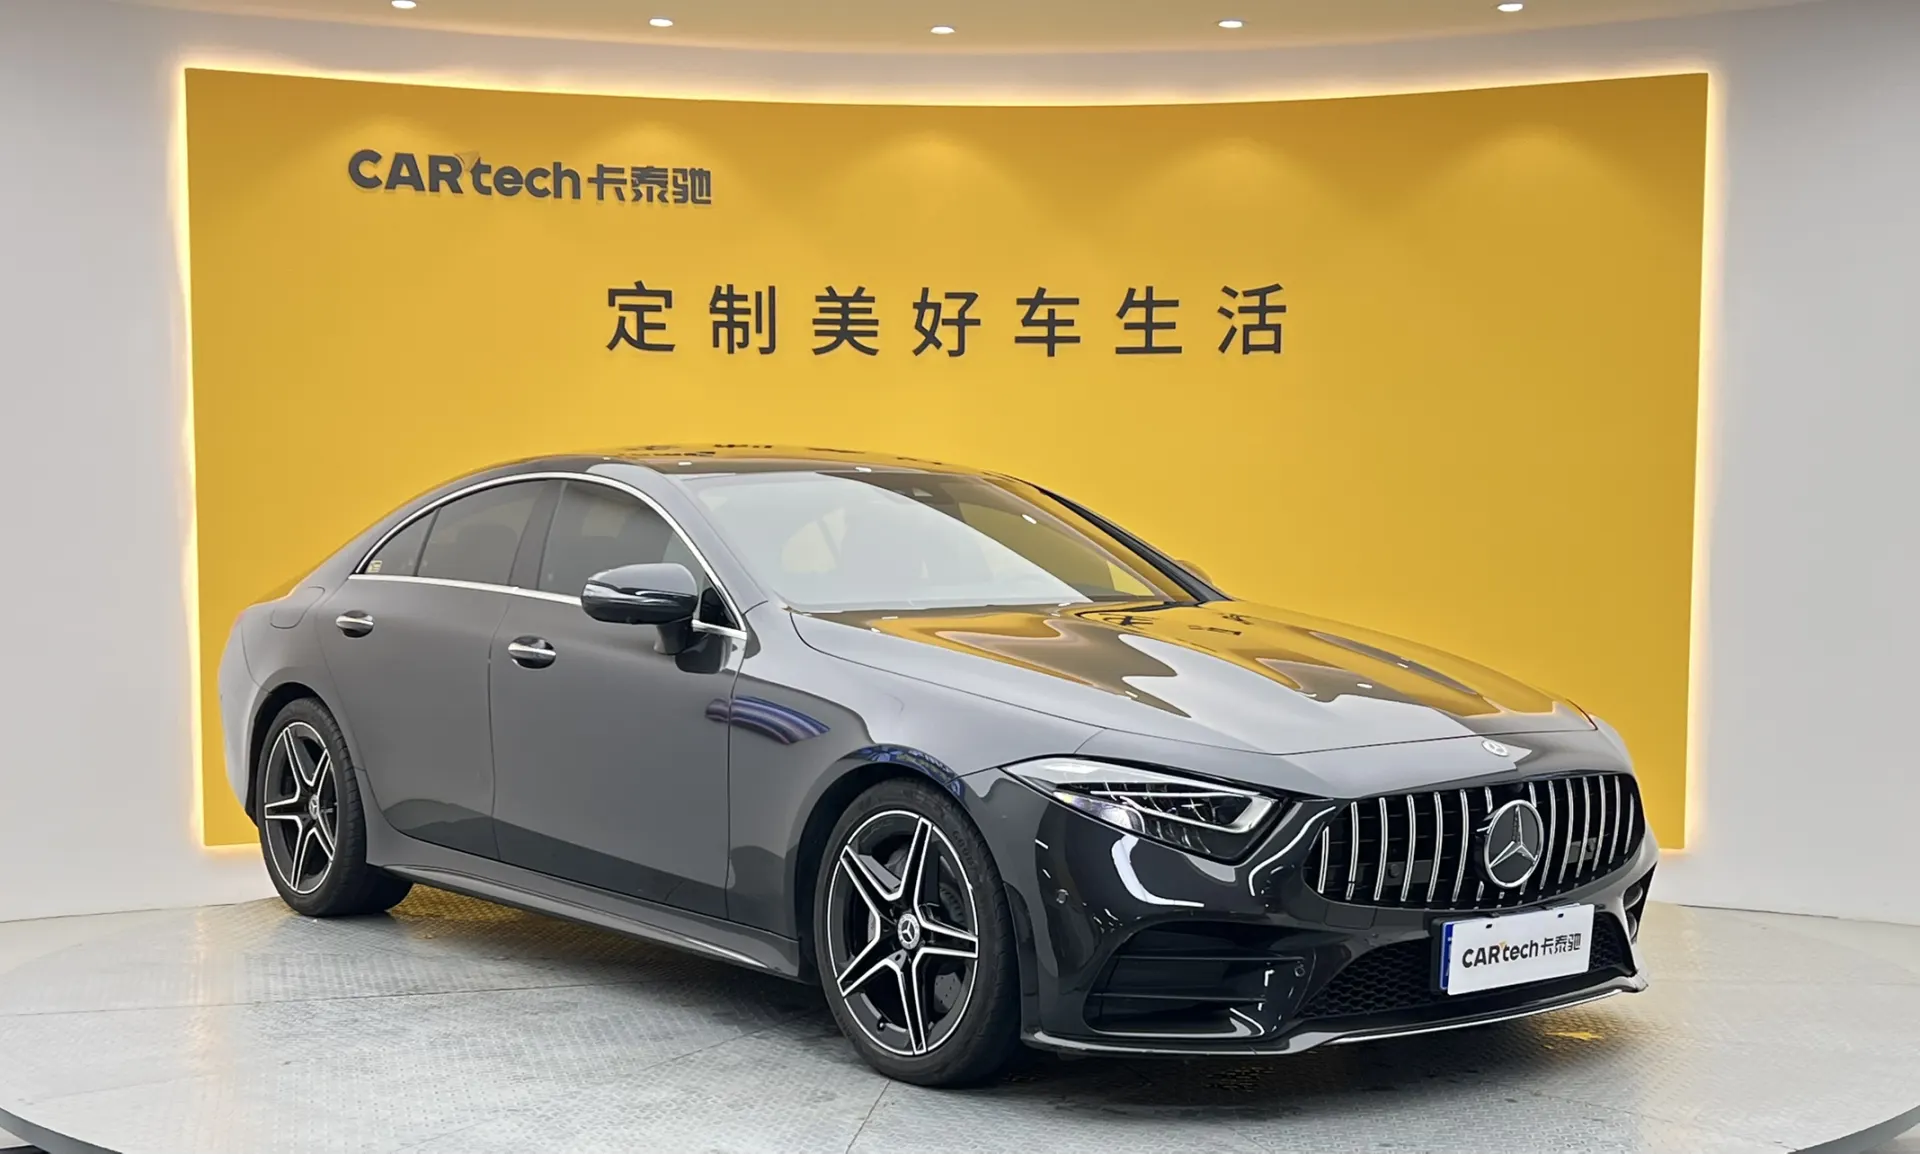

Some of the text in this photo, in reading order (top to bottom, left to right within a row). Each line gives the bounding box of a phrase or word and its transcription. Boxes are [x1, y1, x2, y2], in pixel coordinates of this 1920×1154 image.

[606, 281, 1287, 357] 定制美好车生活
